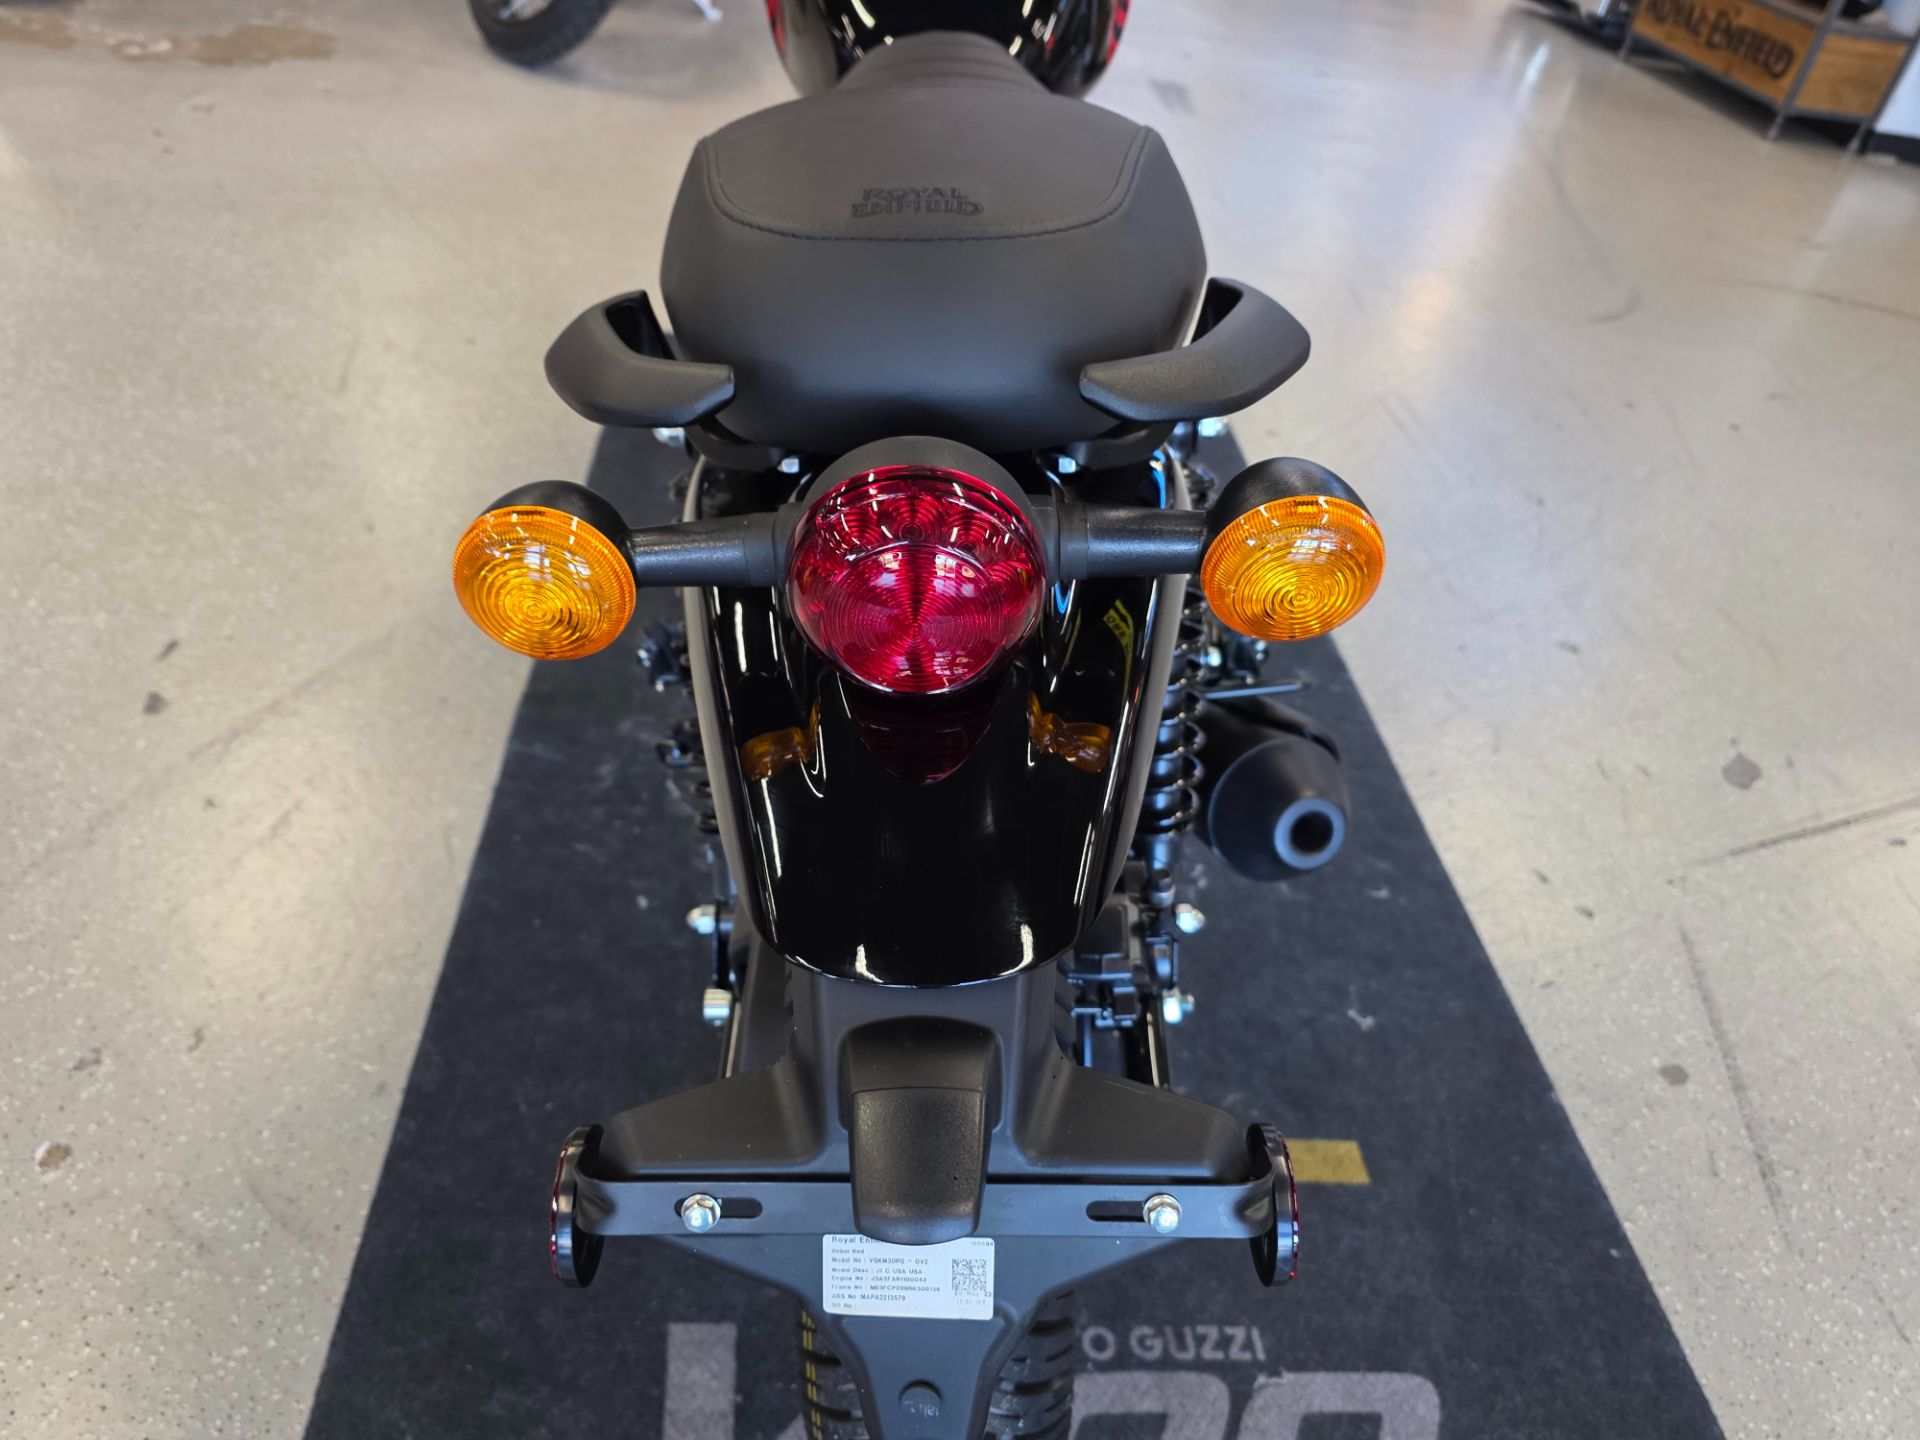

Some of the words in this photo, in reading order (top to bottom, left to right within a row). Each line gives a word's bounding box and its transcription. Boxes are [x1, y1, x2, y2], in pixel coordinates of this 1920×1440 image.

[1705, 9, 1795, 79] ENFIELD
[863, 187, 969, 202] ROYAL
[852, 199, 985, 218] ENFIELD
[831, 1236, 857, 1245] Royal
[1129, 1325, 1267, 1362] GUZZI
